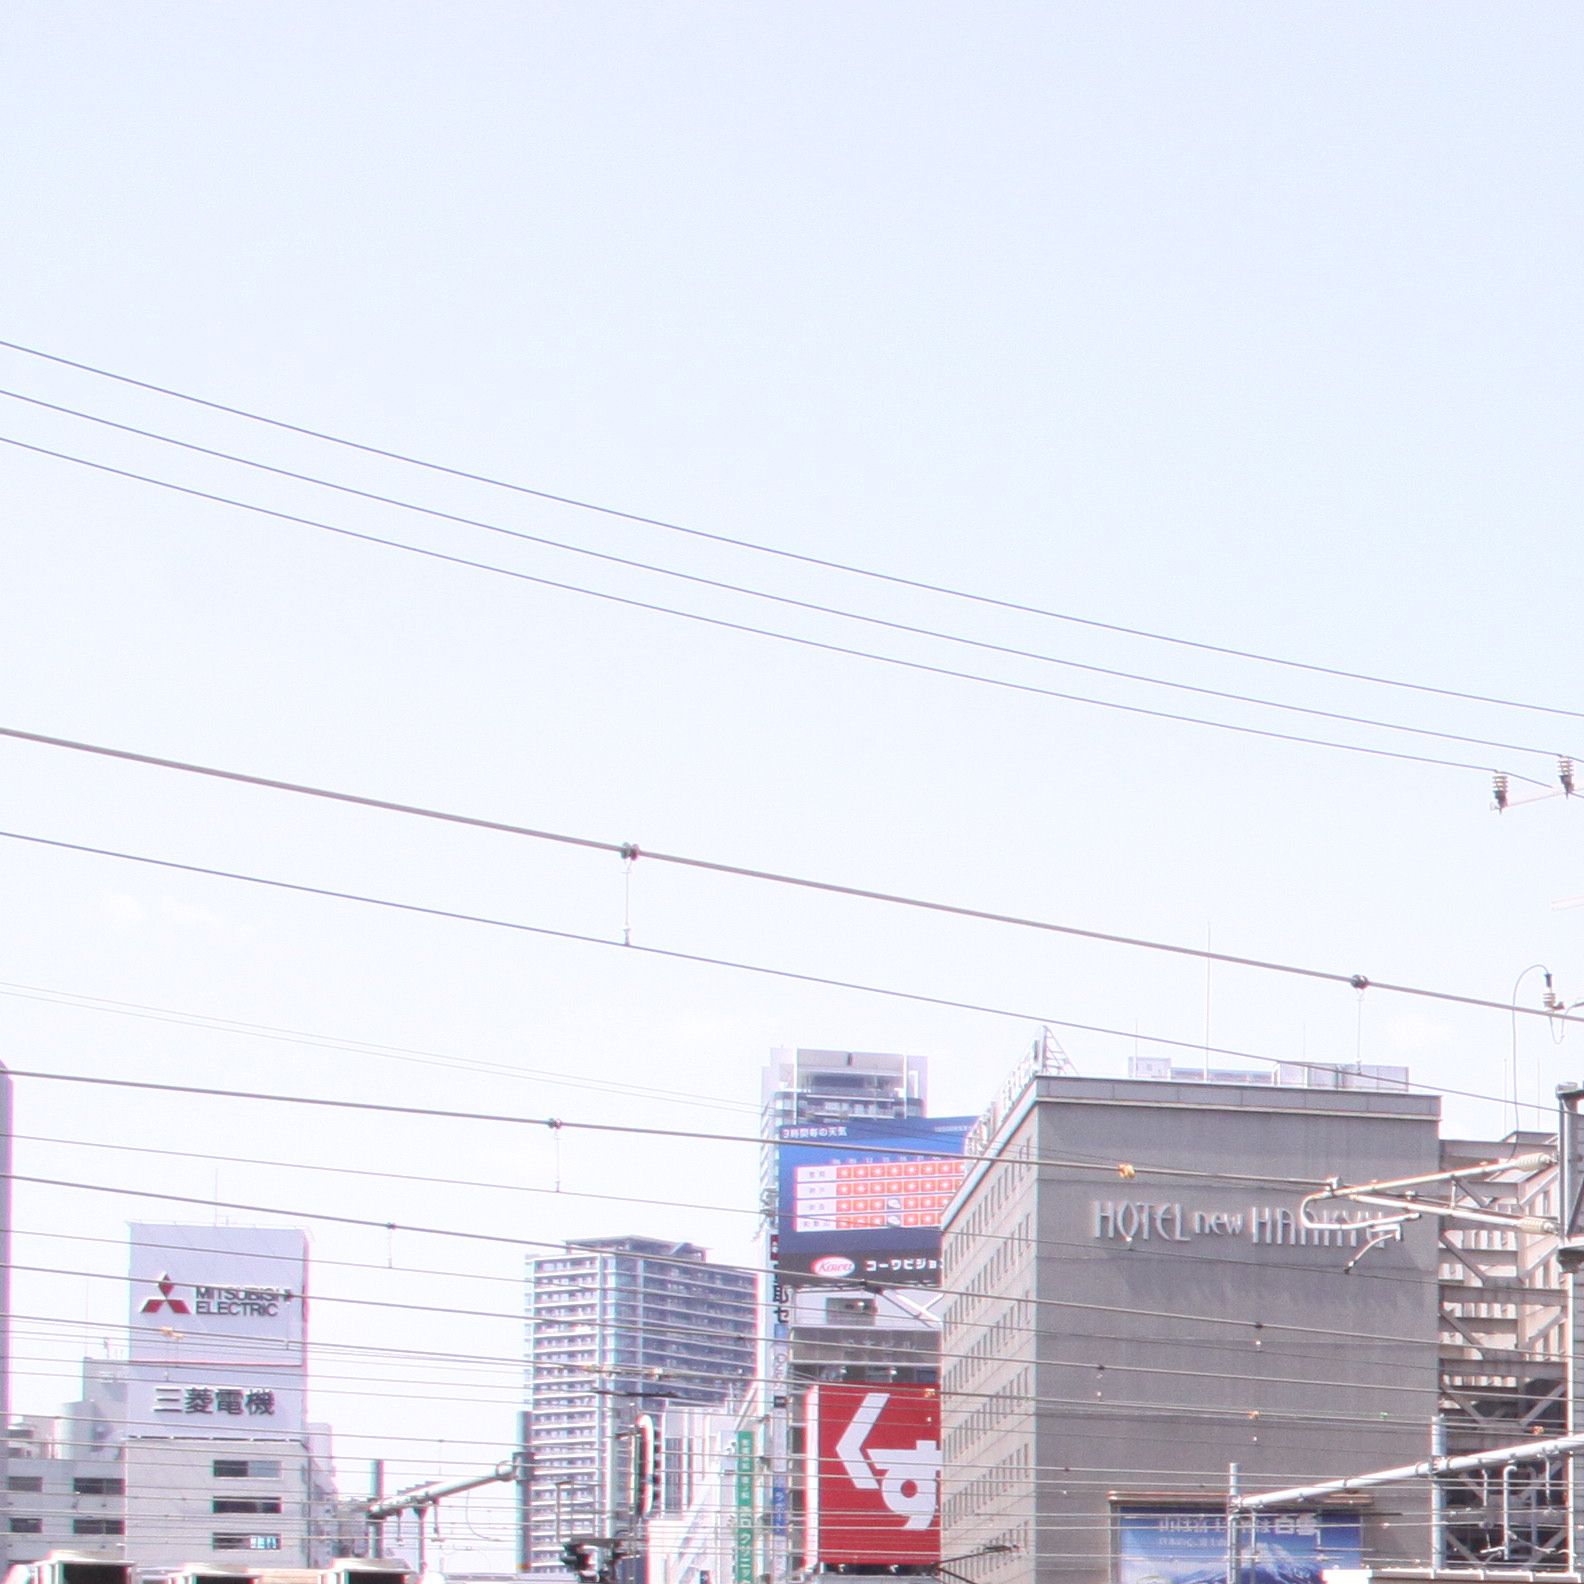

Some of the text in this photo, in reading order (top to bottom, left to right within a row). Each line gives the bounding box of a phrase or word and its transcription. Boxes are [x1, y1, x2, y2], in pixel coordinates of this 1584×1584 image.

[1094, 1201, 1192, 1242] HOTEL
[1195, 1210, 1243, 1235] new
[195, 1301, 278, 1316] ELECTRIC
[153, 1386, 275, 1416] 三菱電機
